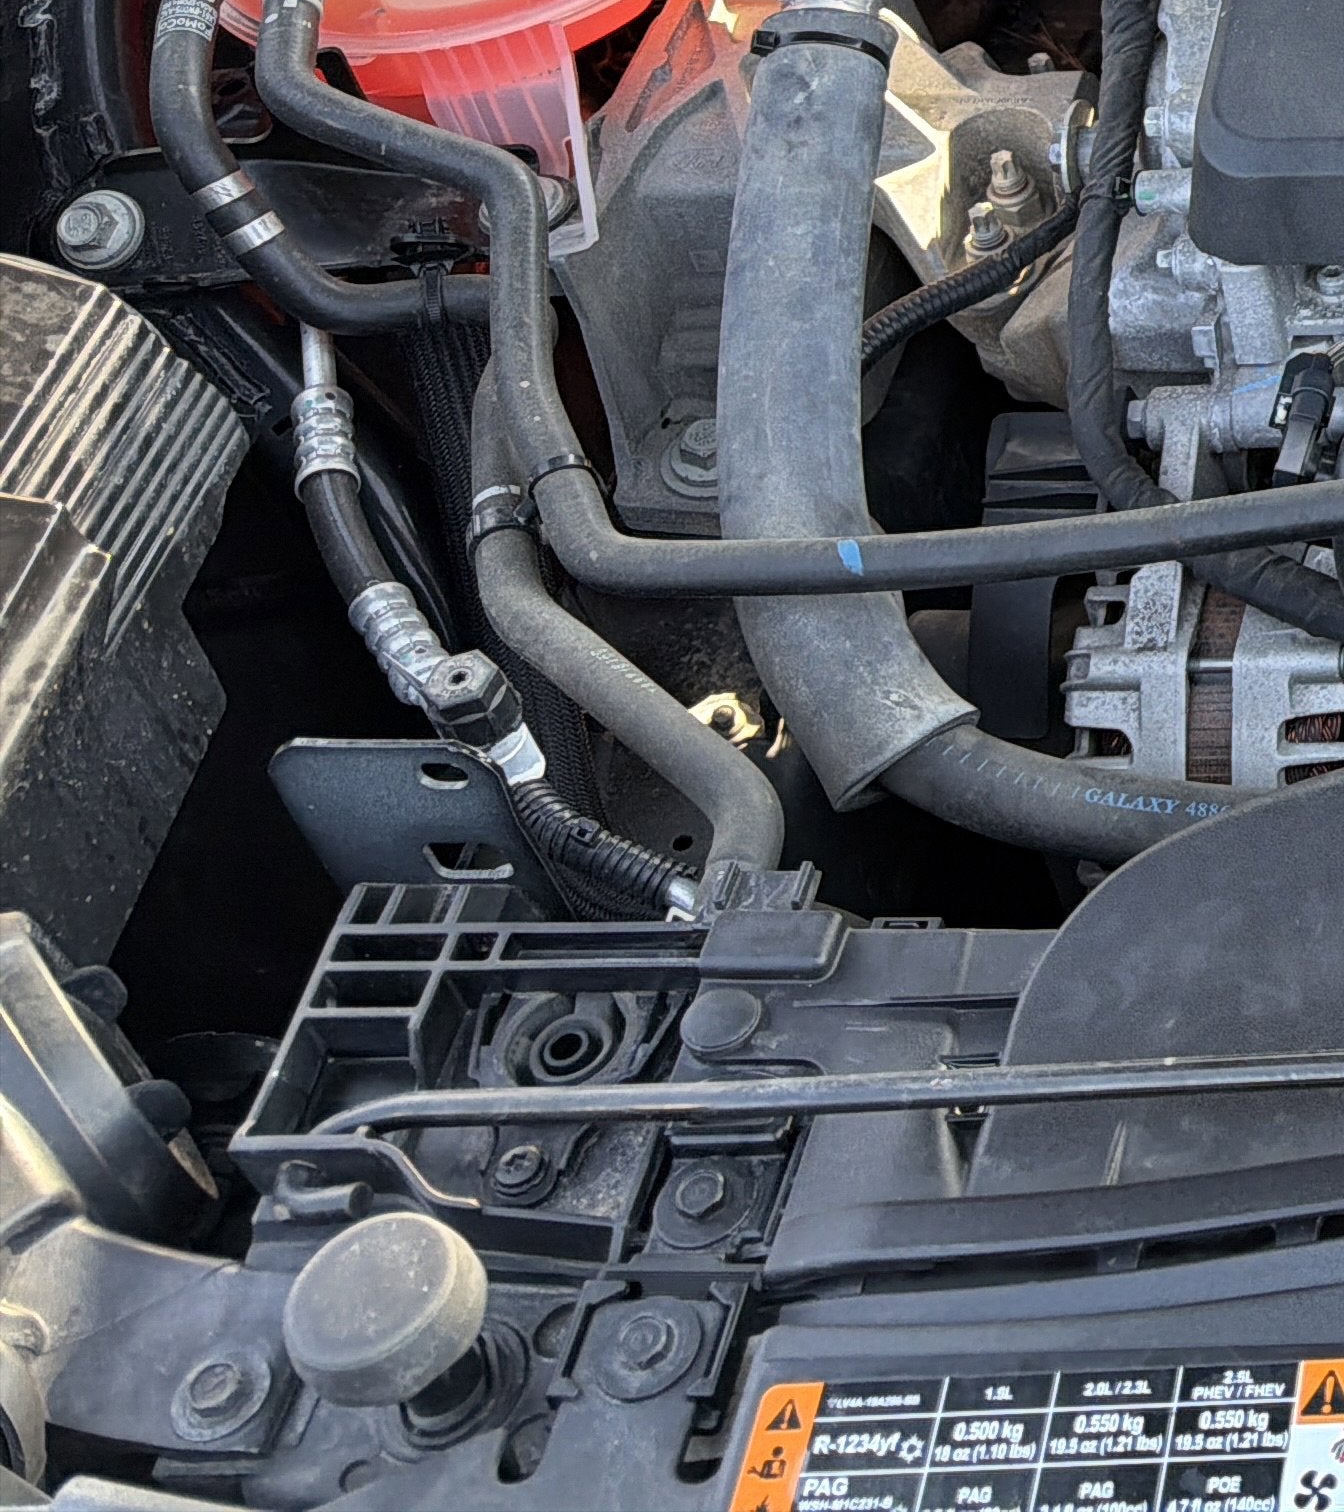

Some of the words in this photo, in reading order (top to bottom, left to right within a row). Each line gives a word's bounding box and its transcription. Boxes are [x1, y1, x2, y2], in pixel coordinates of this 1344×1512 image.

[1085, 787, 1180, 815] GALAXY
[1191, 1384, 1234, 1400] PHEV
[952, 1421, 1000, 1442] 0.500
[1002, 1419, 1025, 1443] kg
[1073, 1414, 1121, 1435] 0.550
[1122, 1412, 1145, 1436] kg
[1198, 1410, 1246, 1431] 0.550
[1247, 1408, 1270, 1432] kg
[812, 1430, 901, 1457] R-1234yf
[952, 1447, 970, 1461] oz
[972, 1444, 1008, 1464] (1.10
[1009, 1441, 1037, 1461] lbs)
[1080, 1440, 1098, 1454] oz
[1099, 1436, 1132, 1457] (1.21
[1133, 1433, 1163, 1454] lbs)
[1206, 1436, 1223, 1450] oz
[1225, 1432, 1260, 1453] (1.21
[1261, 1429, 1290, 1451] lbs)
[803, 1478, 849, 1496] PAG
[957, 1486, 993, 1504] PAG
[1077, 1481, 1115, 1500] PAG
[1207, 1475, 1243, 1494] POE
[1224, 1495, 1276, 1512] (140cc)
